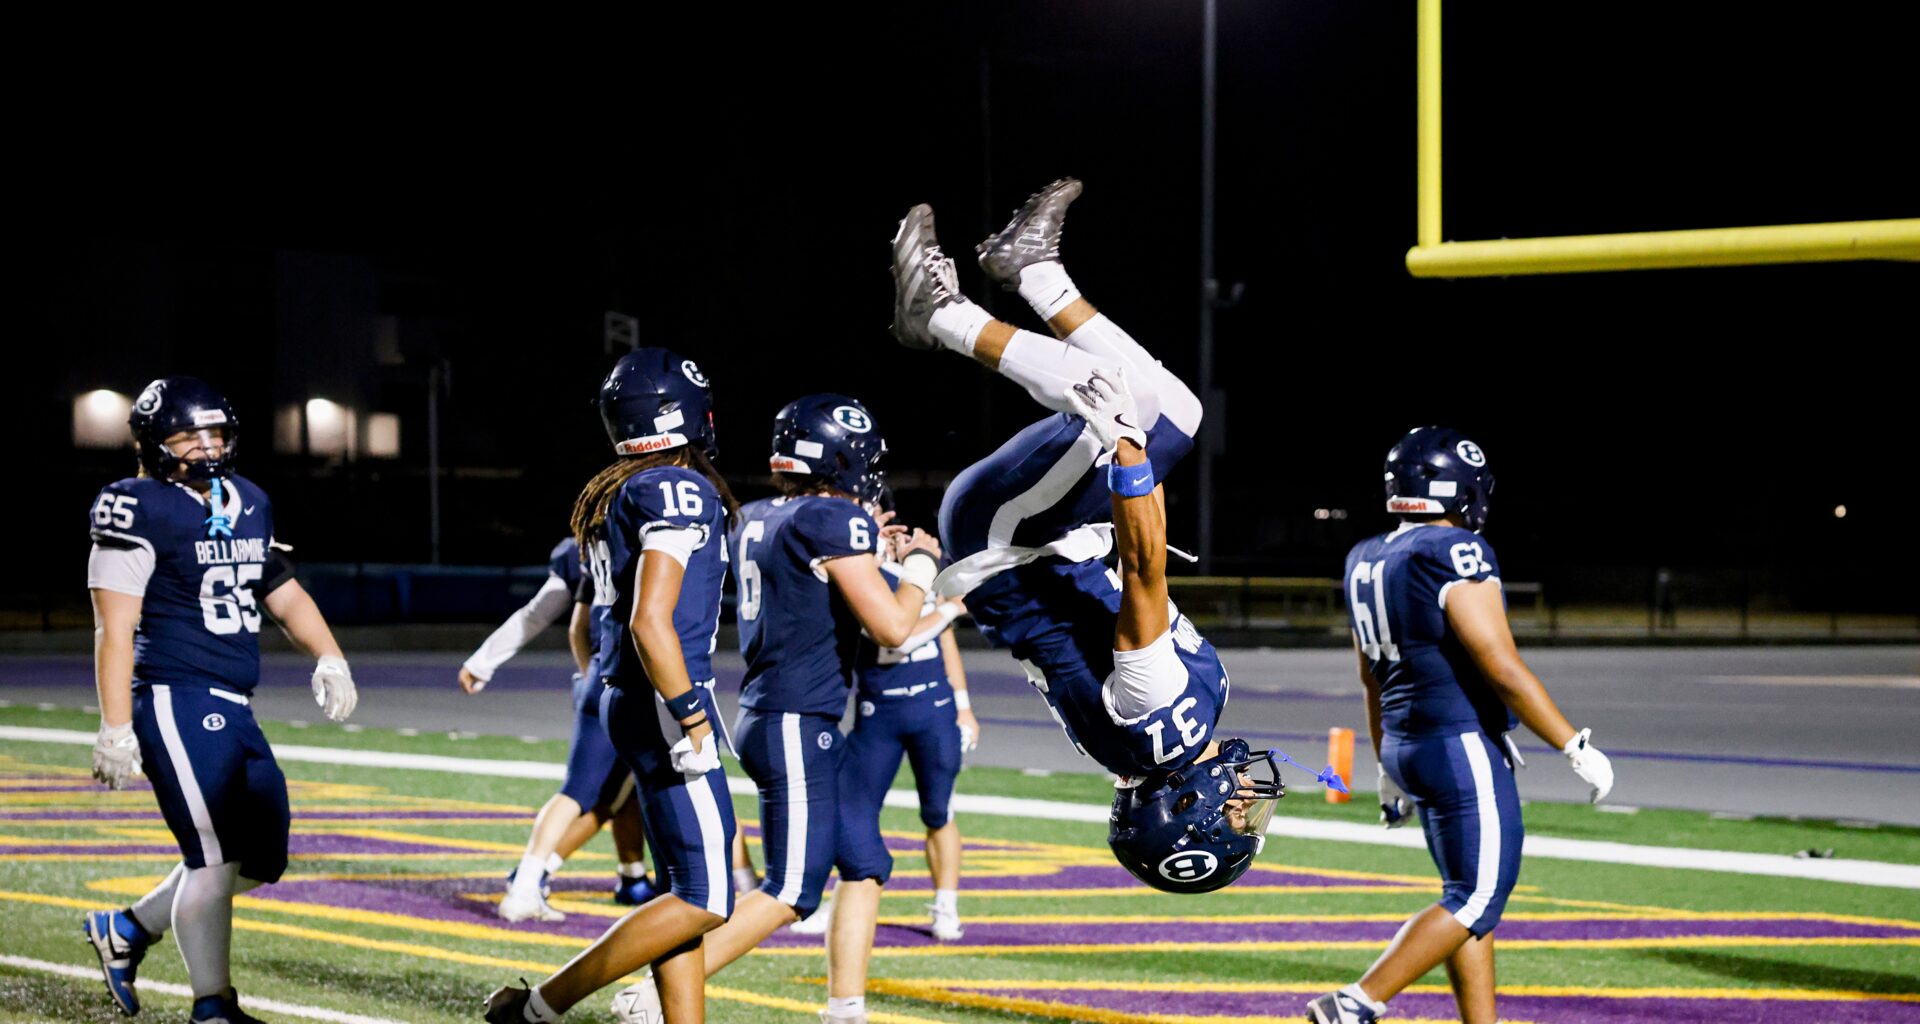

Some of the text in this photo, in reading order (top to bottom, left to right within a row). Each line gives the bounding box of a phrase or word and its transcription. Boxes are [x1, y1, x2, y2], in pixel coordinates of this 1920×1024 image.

[837, 408, 868, 430] B
[624, 437, 671, 454] Riddell
[1460, 443, 1483, 464] B
[95, 493, 138, 530] 65
[659, 480, 703, 518] 16
[194, 538, 266, 564] BELLARMINE
[849, 516, 871, 550] 6
[739, 519, 765, 621] 6
[1450, 542, 1492, 578] 61
[199, 564, 263, 635] 65
[1350, 560, 1401, 661] 61
[1145, 697, 1208, 766] 37
[1162, 854, 1213, 882] B
